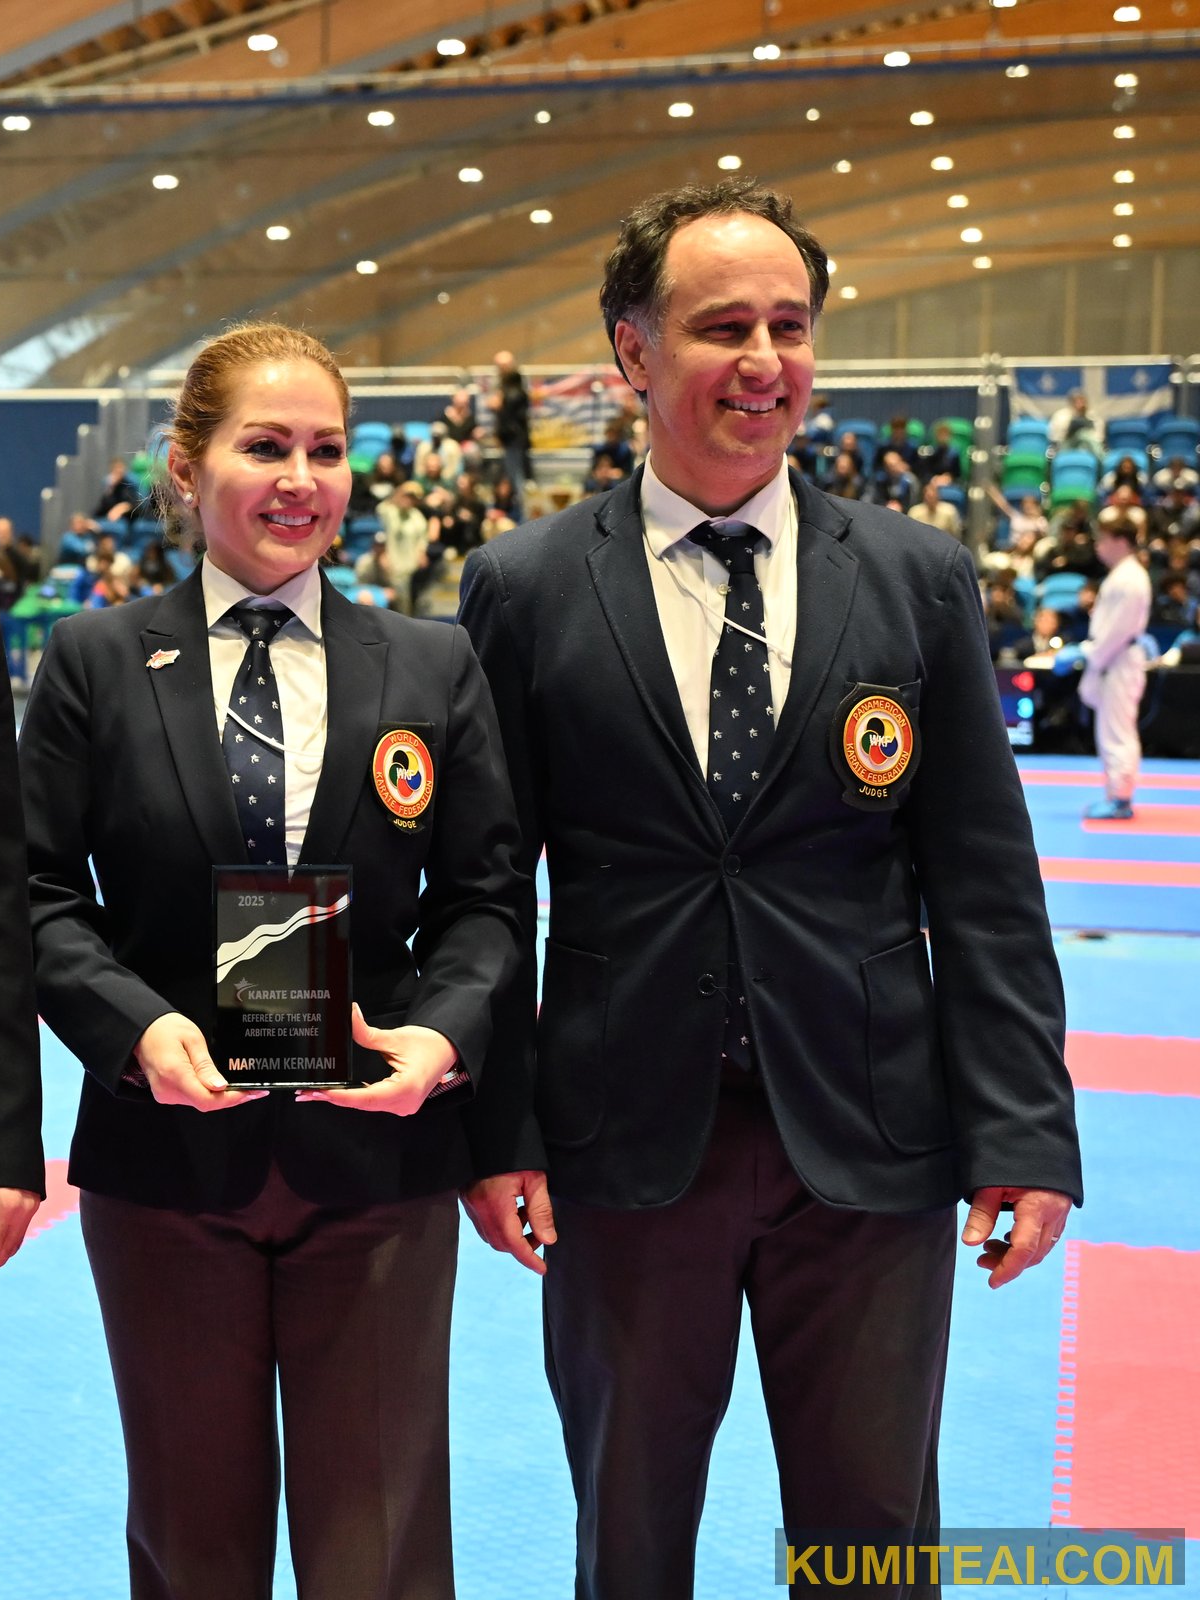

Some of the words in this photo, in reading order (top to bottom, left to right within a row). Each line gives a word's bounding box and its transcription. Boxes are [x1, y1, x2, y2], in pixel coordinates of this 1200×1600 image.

[853, 700, 907, 728] PANAMERICAN
[389, 733, 419, 747] WORLD
[846, 742, 867, 777] KARATE
[867, 751, 909, 783] FEDERATION
[376, 771, 397, 809] KARATE
[398, 780, 432, 815] FEDERATION
[859, 785, 888, 798] JUDGE
[393, 818, 417, 829] JUDGE
[238, 895, 265, 907] 2025
[248, 989, 288, 1000] KARATE
[290, 989, 331, 1000] CANADA
[242, 1013, 273, 1023] REFEREE
[275, 1013, 285, 1023] OF
[287, 1013, 301, 1022] THE
[303, 1013, 322, 1022] YEAR
[245, 1028, 276, 1038] ARBITRE
[278, 1028, 288, 1037] DE
[289, 1025, 320, 1037] L'ANNÉE
[228, 1057, 281, 1071] MARYAM
[283, 1056, 336, 1070] KERMANI
